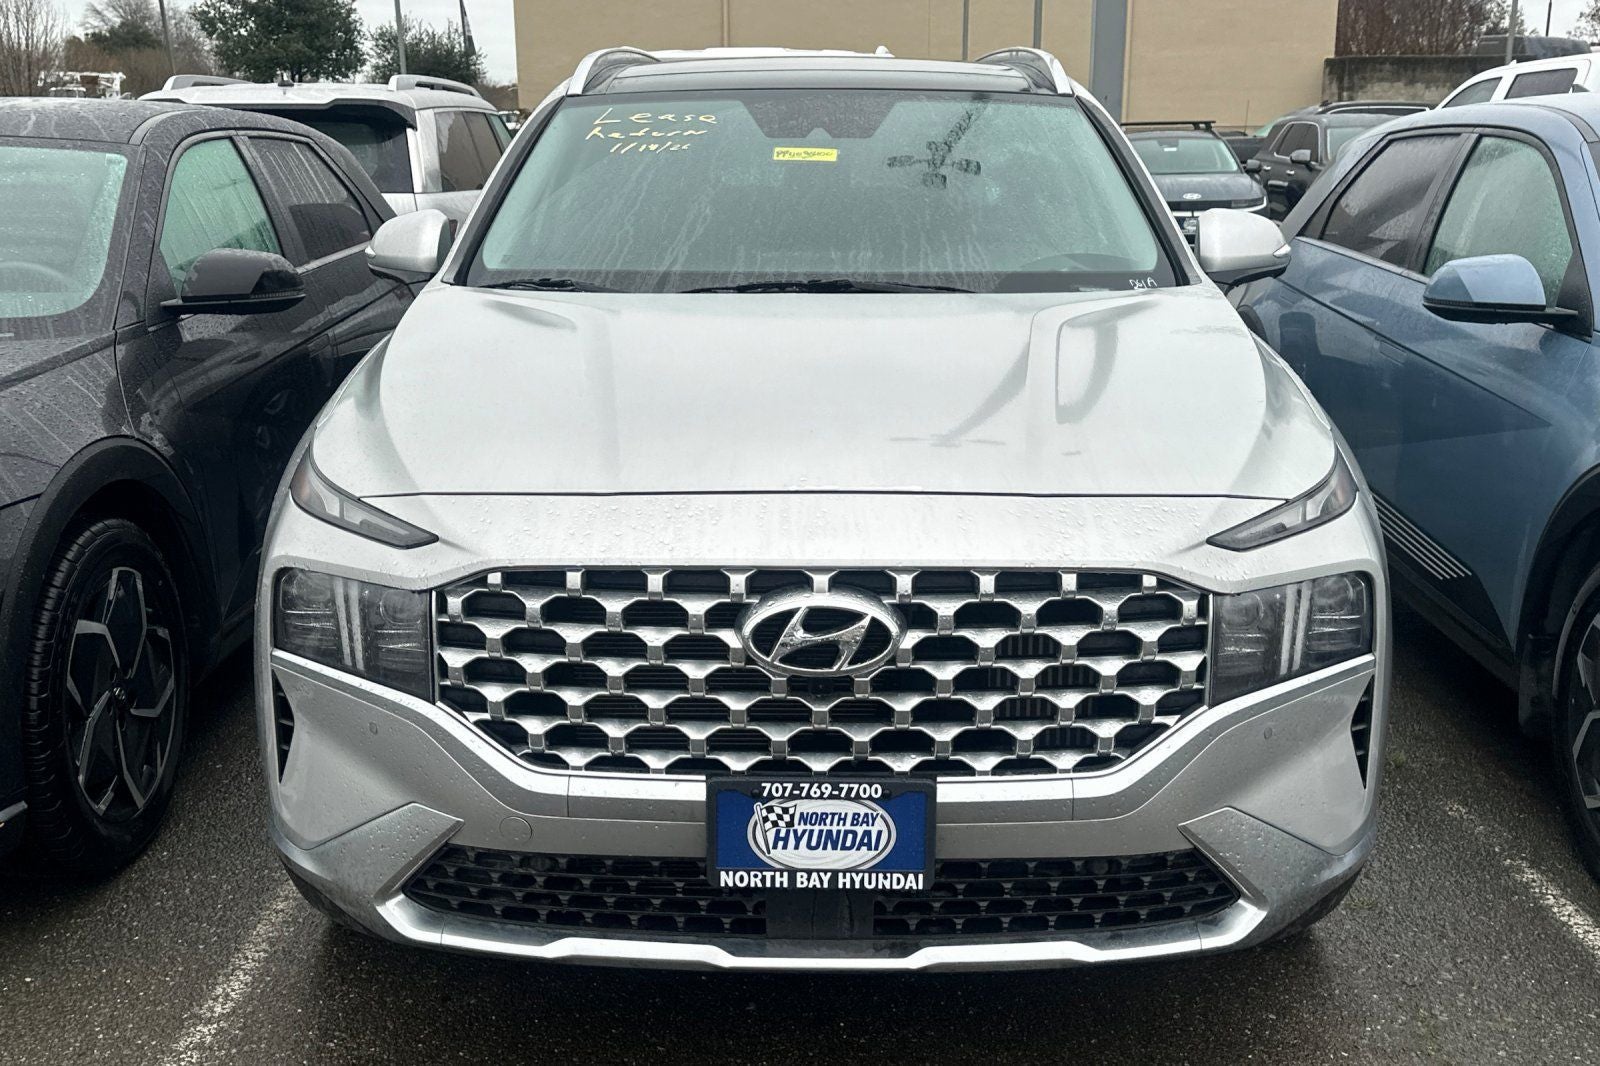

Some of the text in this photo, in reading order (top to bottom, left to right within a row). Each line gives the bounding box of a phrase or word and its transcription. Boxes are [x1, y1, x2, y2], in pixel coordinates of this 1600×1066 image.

[761, 782, 883, 798] 707-769-7700
[798, 811, 880, 827] NORTH BAY
[772, 829, 883, 851] HYUNDAI
[720, 870, 924, 890] NORTH BAY HYUNDAI
